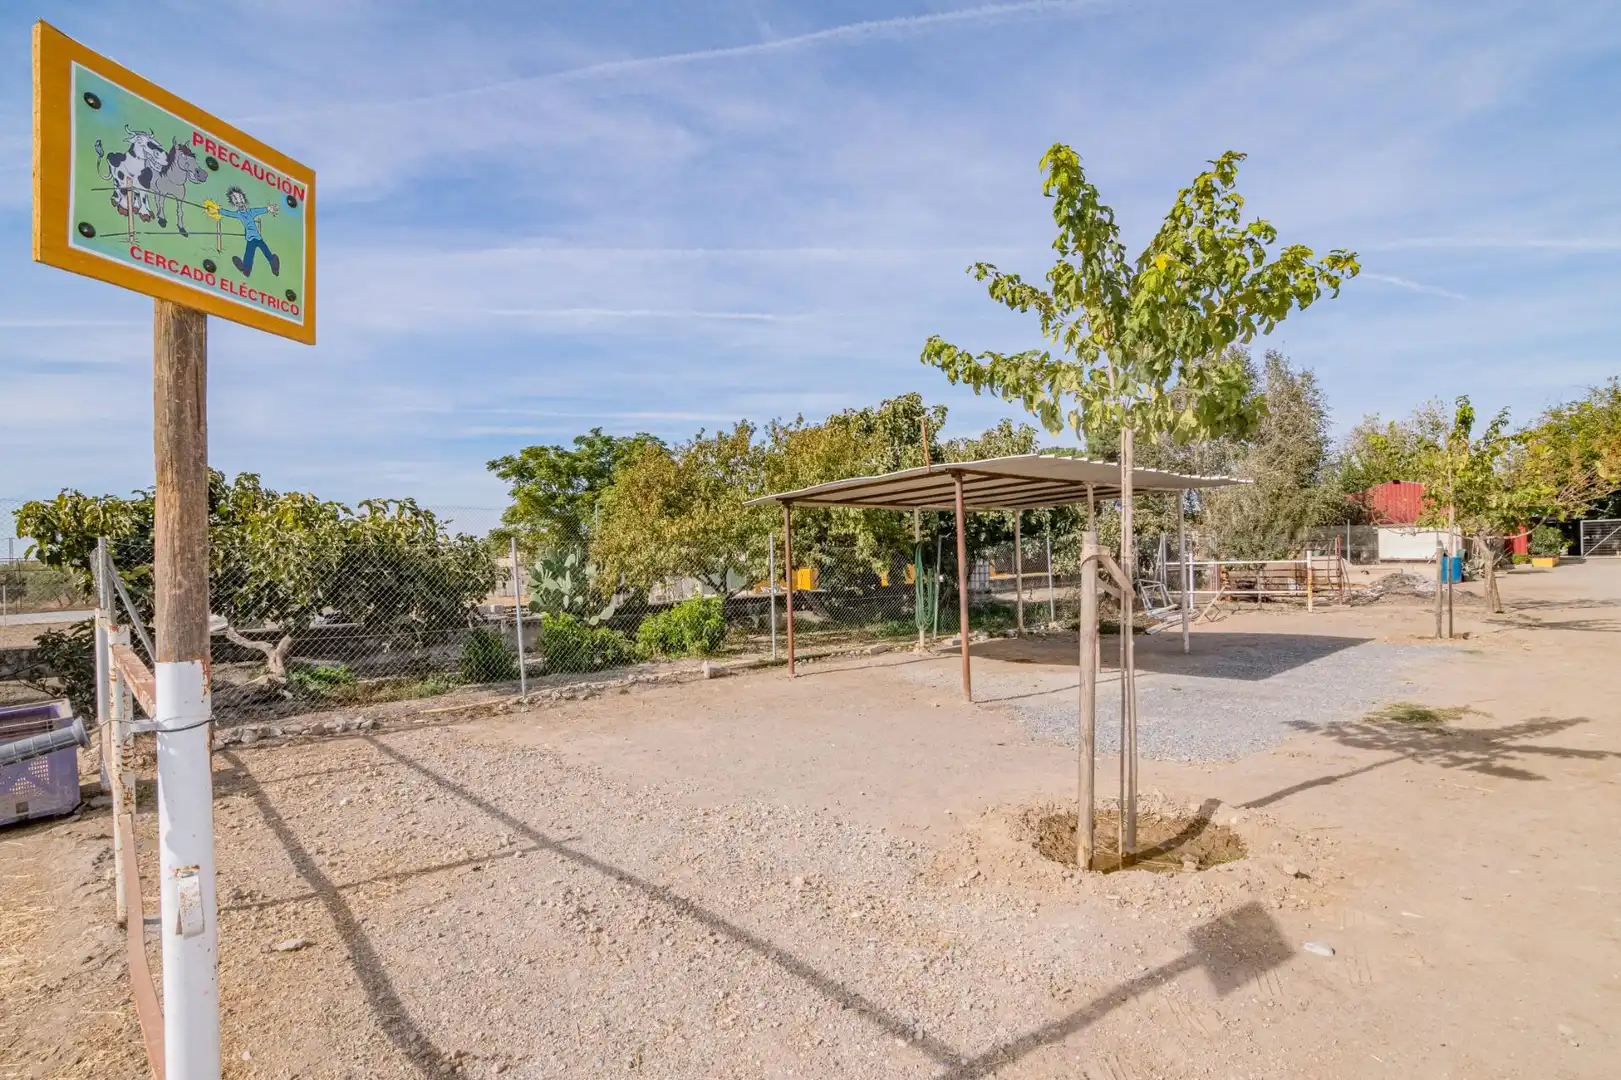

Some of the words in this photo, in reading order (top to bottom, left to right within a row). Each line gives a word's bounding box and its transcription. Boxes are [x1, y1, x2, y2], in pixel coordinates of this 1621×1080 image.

[192, 131, 305, 201] PRECAUCIÓN
[130, 245, 216, 286] CERCADO
[220, 277, 299, 316] ELÉCTRICO
